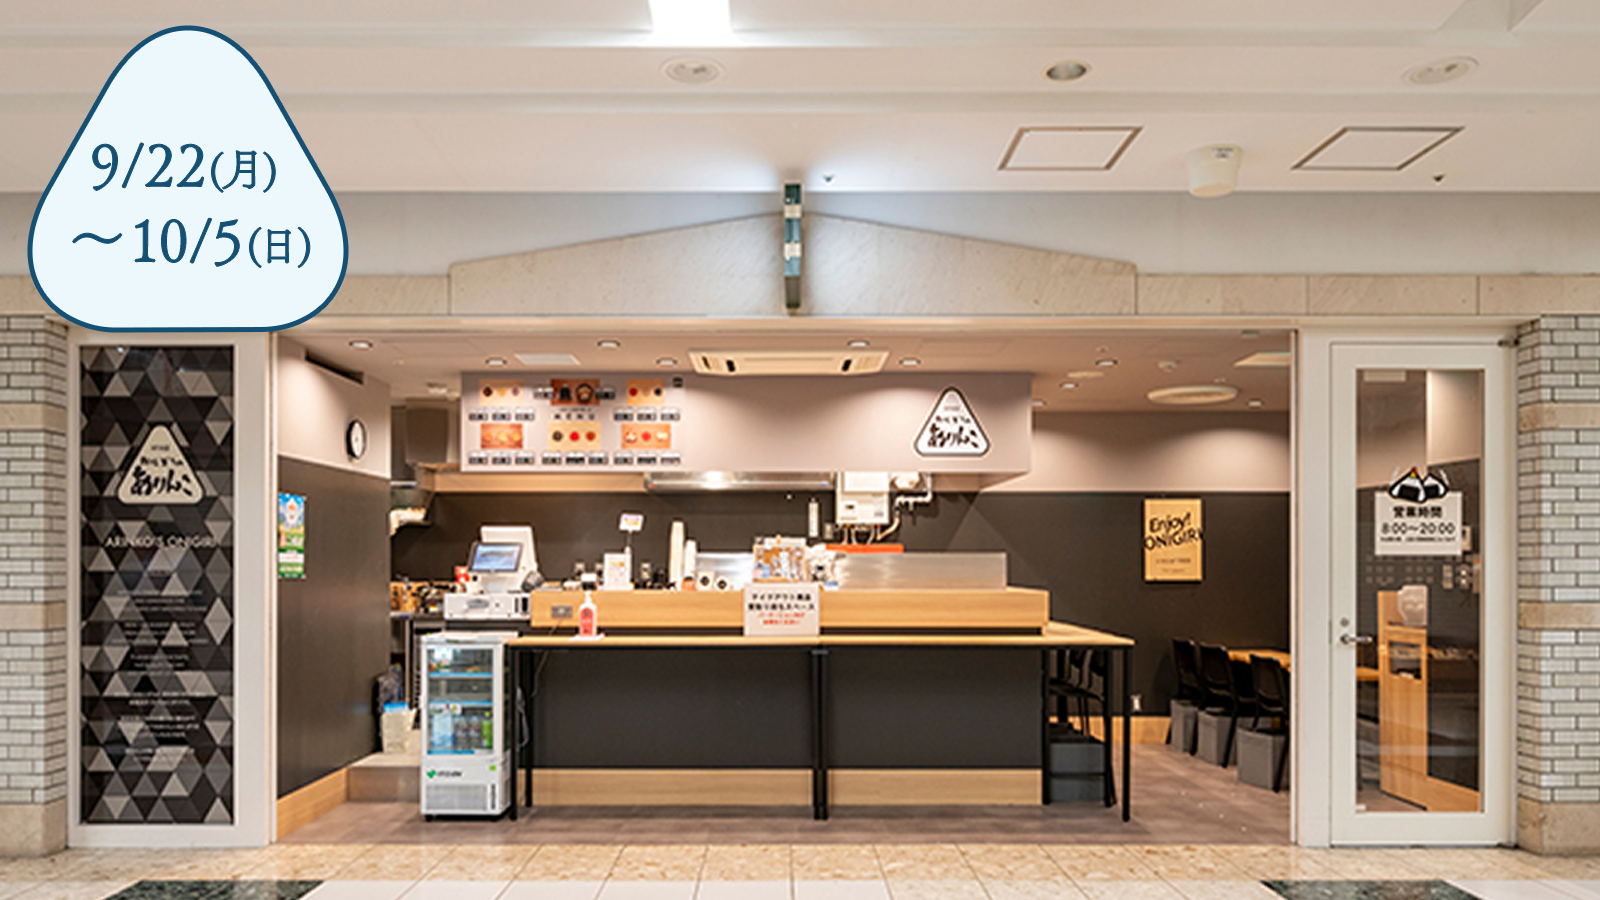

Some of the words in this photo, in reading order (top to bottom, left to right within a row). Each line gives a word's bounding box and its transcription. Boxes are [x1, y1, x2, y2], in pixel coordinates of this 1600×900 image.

[130, 465, 193, 497] ありんこ
[1149, 511, 1192, 534] Enjoy!
[1392, 505, 1443, 518] 営業時間
